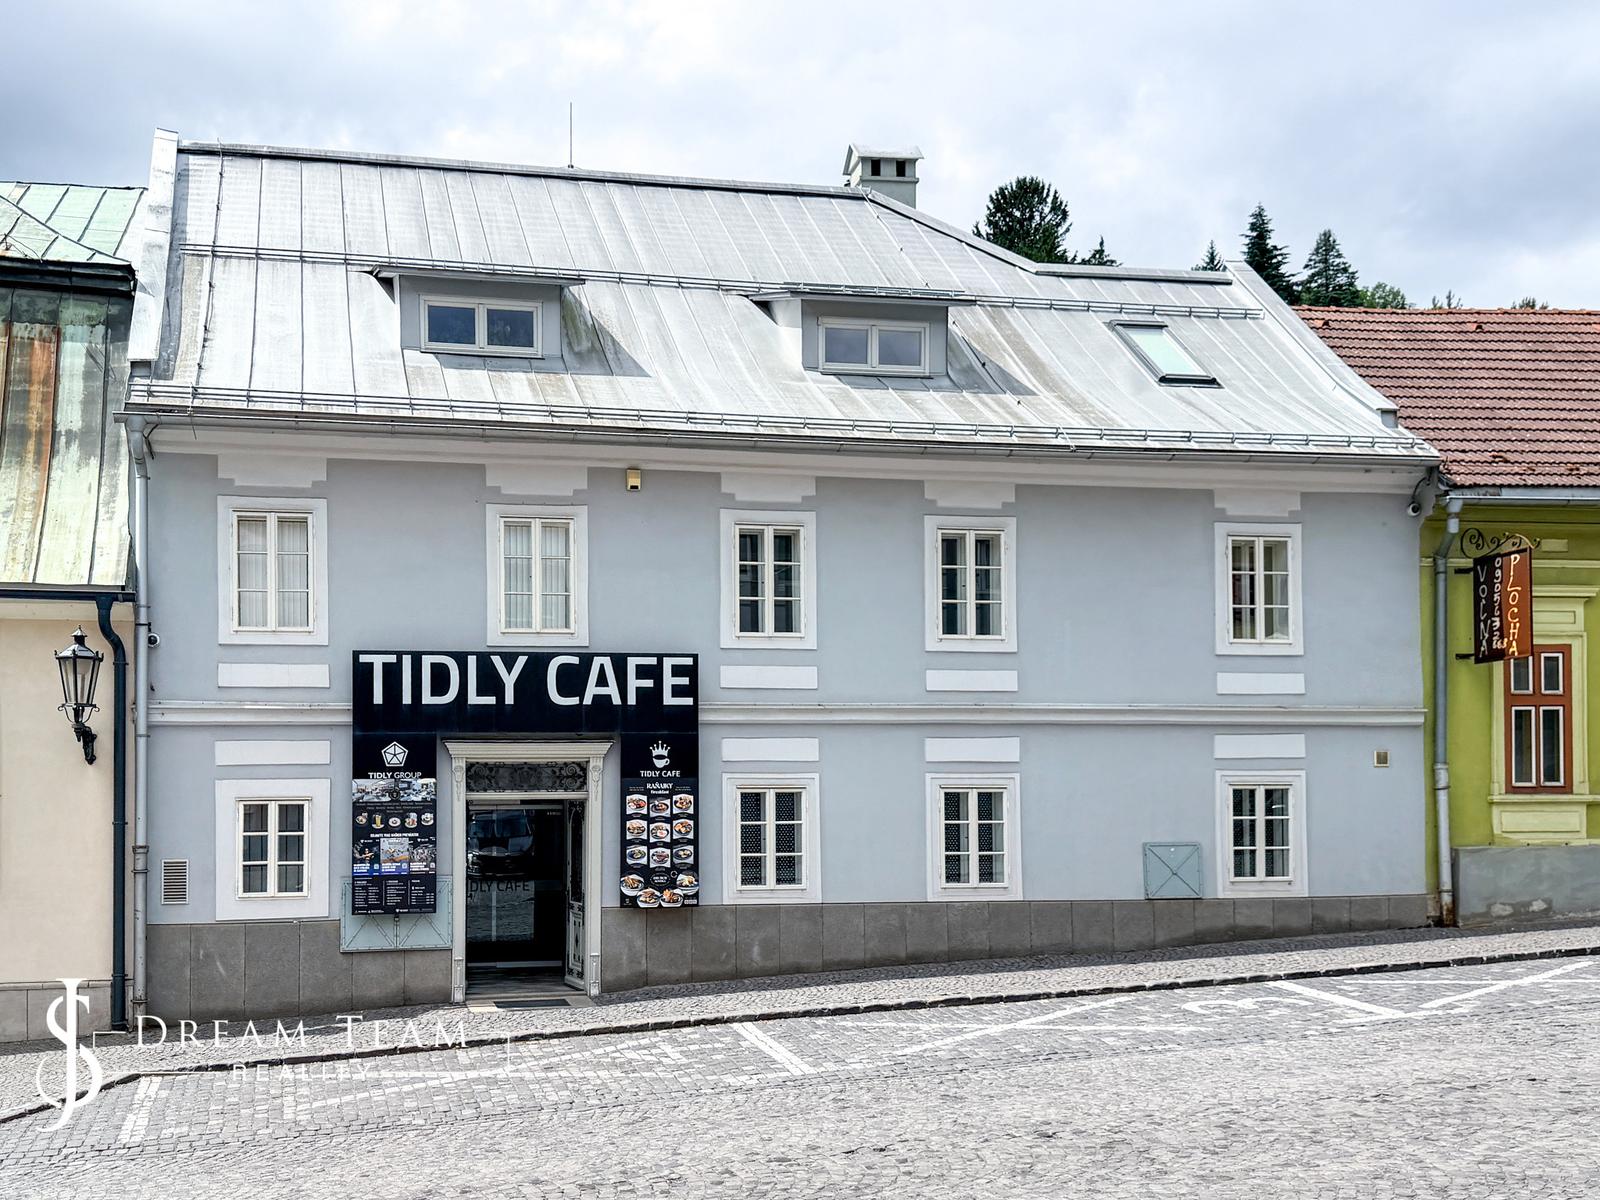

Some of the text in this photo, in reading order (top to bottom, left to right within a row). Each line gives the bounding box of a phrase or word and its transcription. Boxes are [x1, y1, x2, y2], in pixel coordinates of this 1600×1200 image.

[1507, 554, 1521, 656] PLOCHA
[359, 654, 694, 706] TIDLY CAFE
[496, 880, 530, 891] CAFE
